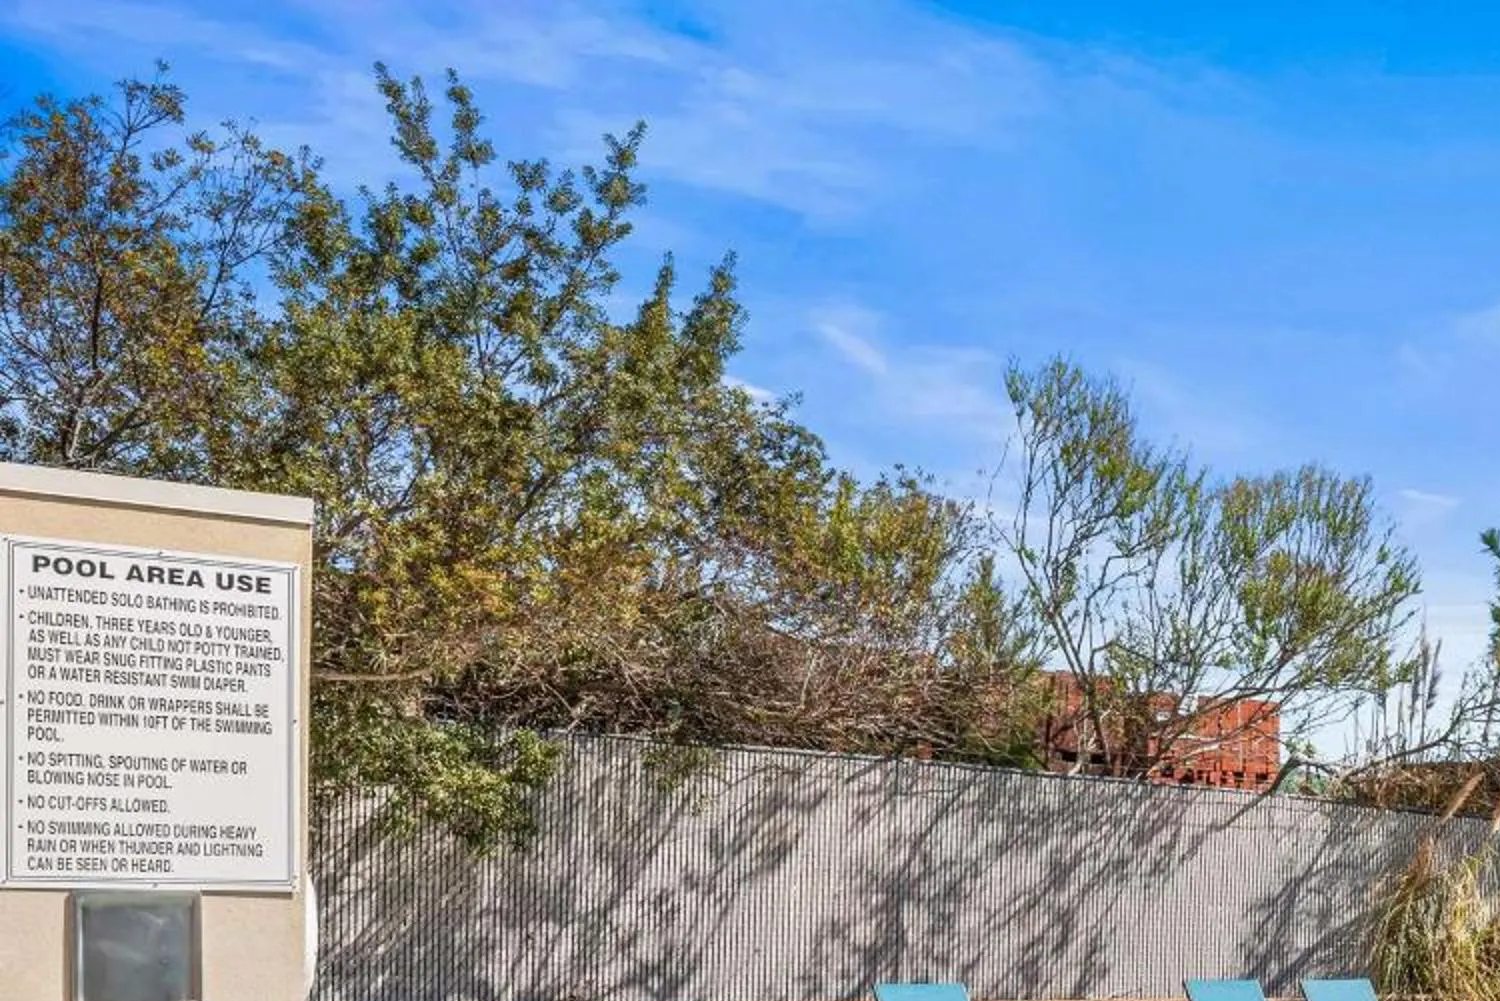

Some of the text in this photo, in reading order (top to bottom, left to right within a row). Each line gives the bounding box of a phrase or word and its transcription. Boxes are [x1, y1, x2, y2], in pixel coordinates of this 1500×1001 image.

[32, 555, 272, 594] POOL AREA USE
[28, 585, 108, 605] UNATTENDED
[111, 592, 143, 609] SOLO
[147, 595, 196, 613] BATHING
[200, 600, 210, 615] IS
[96, 616, 134, 632] THREE
[138, 619, 176, 636] YEARS
[180, 622, 202, 637] OLD
[206, 625, 212, 639] &
[29, 629, 45, 643] AS
[48, 630, 81, 646] WELL
[84, 633, 100, 647] AS
[103, 635, 126, 649] ANY
[130, 636, 164, 653] CHILD
[168, 640, 191, 655] NOT
[195, 641, 230, 657] POTTY
[28, 647, 271, 677] MUST WEAR SNUG FITTING PLASTIC PANTS
[28, 664, 45, 679] OR
[49, 666, 57, 680] A
[60, 667, 101, 683] WATER
[104, 669, 168, 687] RESISTANT
[170, 674, 201, 689] SWIM
[28, 689, 45, 705] NO
[89, 693, 124, 710] DRINK
[129, 695, 145, 710] OR
[148, 697, 213, 715] WRAPPERS
[215, 701, 252, 717] SHALL
[255, 703, 269, 719] BE
[28, 707, 273, 735] PERMITTED WITHIN 10FT OF THE SWIMMING
[28, 725, 64, 742] POOL.
[28, 751, 45, 767] NO
[109, 755, 168, 771] SPOUTING
[171, 757, 187, 773] OF
[189, 759, 229, 774] WATER
[231, 761, 248, 775] OR
[28, 769, 173, 789] BLOWING NOSE IN POOL.
[28, 794, 171, 814] NO CUT-OFFS ALLOWED.
[28, 819, 257, 841] NO SWIMMING ALLOWED DURING HEAVY
[28, 838, 264, 857] RAIN OR WHEN THUNDER AND LIGHTNING
[28, 856, 175, 873] CAN BE SEEN OR HEARD.
